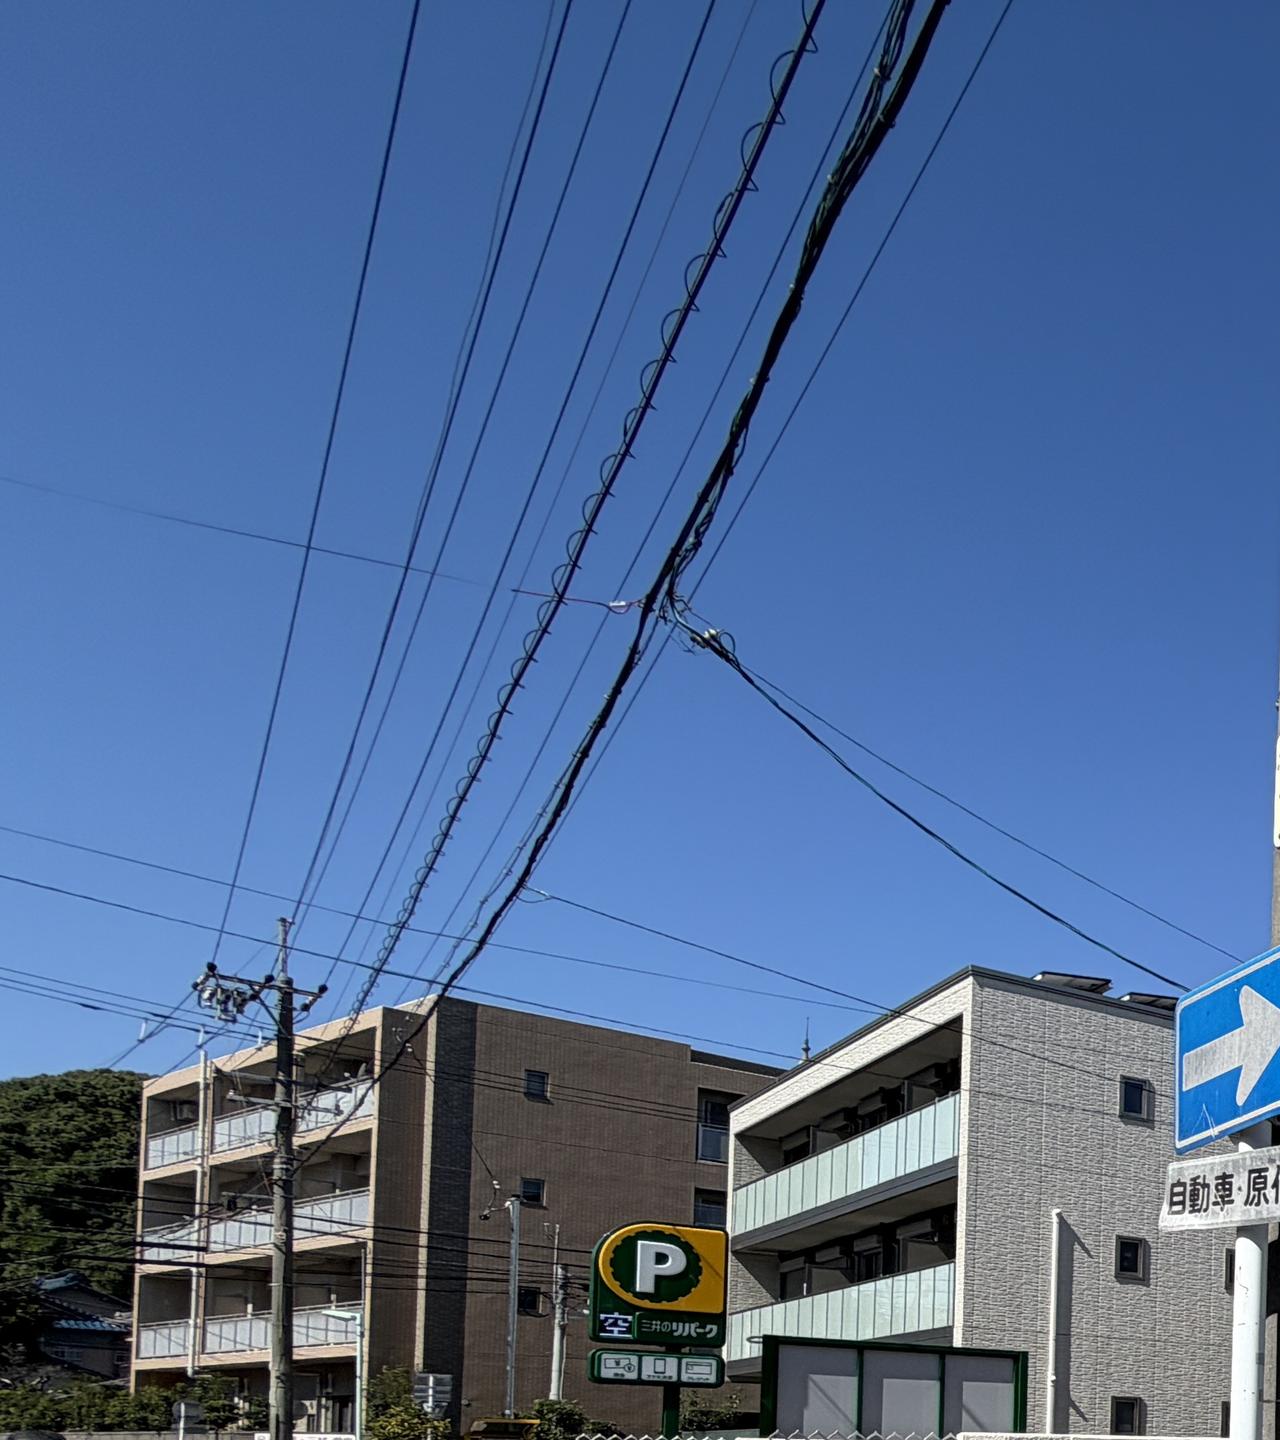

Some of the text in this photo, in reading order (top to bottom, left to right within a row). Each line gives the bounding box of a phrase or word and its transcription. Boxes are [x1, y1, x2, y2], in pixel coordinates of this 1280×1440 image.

[635, 1240, 688, 1294] P
[600, 1312, 633, 1338] 空
[641, 1319, 718, 1338] 三井のリパーク
